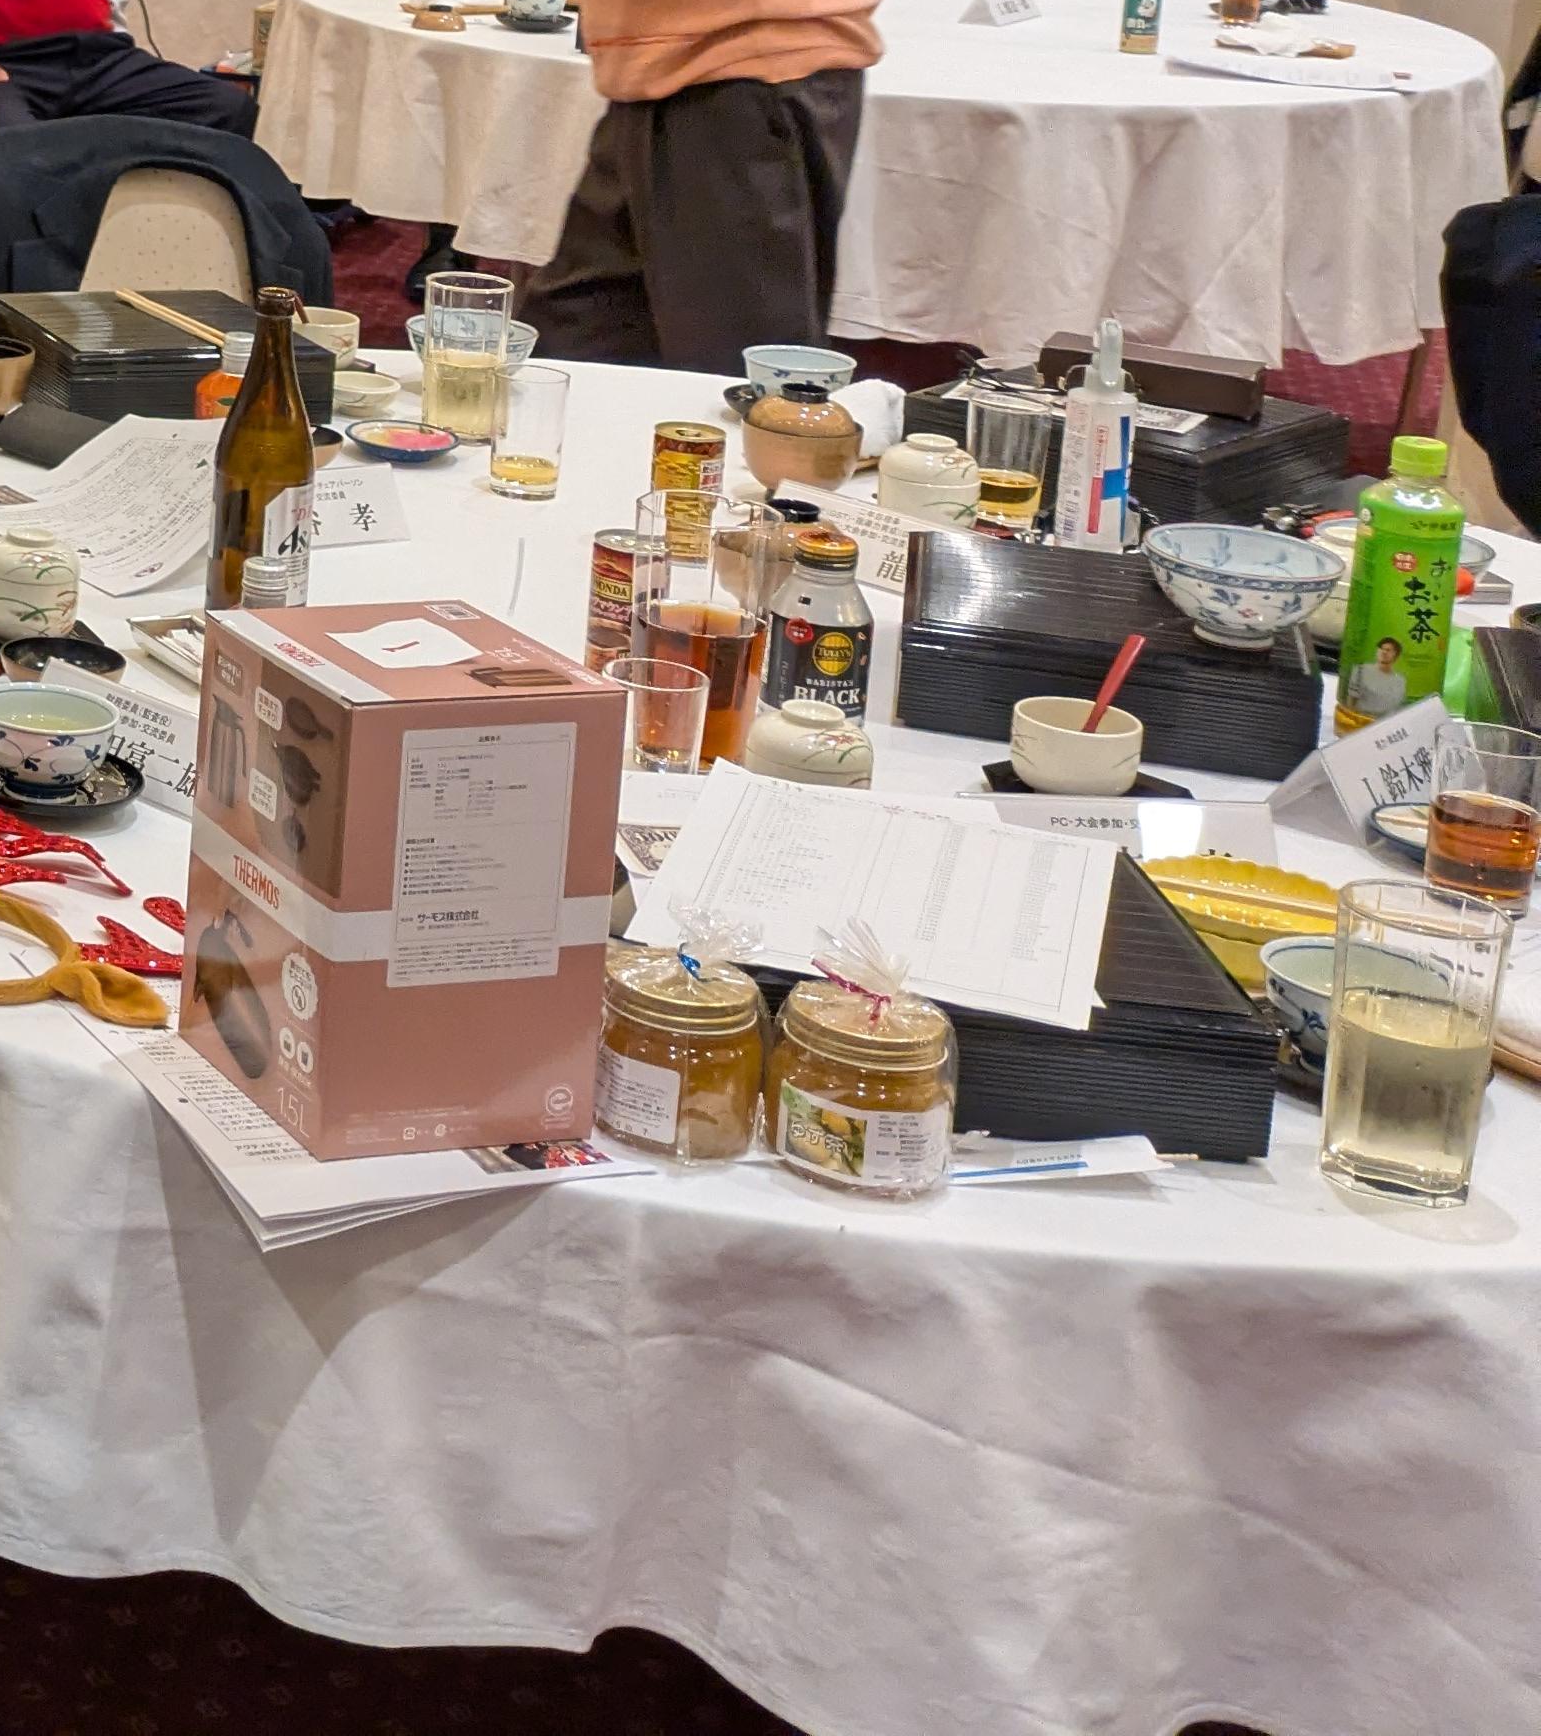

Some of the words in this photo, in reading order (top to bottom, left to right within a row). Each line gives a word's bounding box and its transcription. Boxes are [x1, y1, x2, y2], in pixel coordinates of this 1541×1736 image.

[1402, 575, 1441, 644] お茶
[817, 646, 853, 658] TULLY'S
[805, 677, 855, 688] BARISTA'S
[793, 685, 861, 705] BLACK
[233, 854, 281, 910] THERMOS
[417, 909, 480, 924] サーモス株式会社
[276, 1086, 310, 1139] 1.5L
